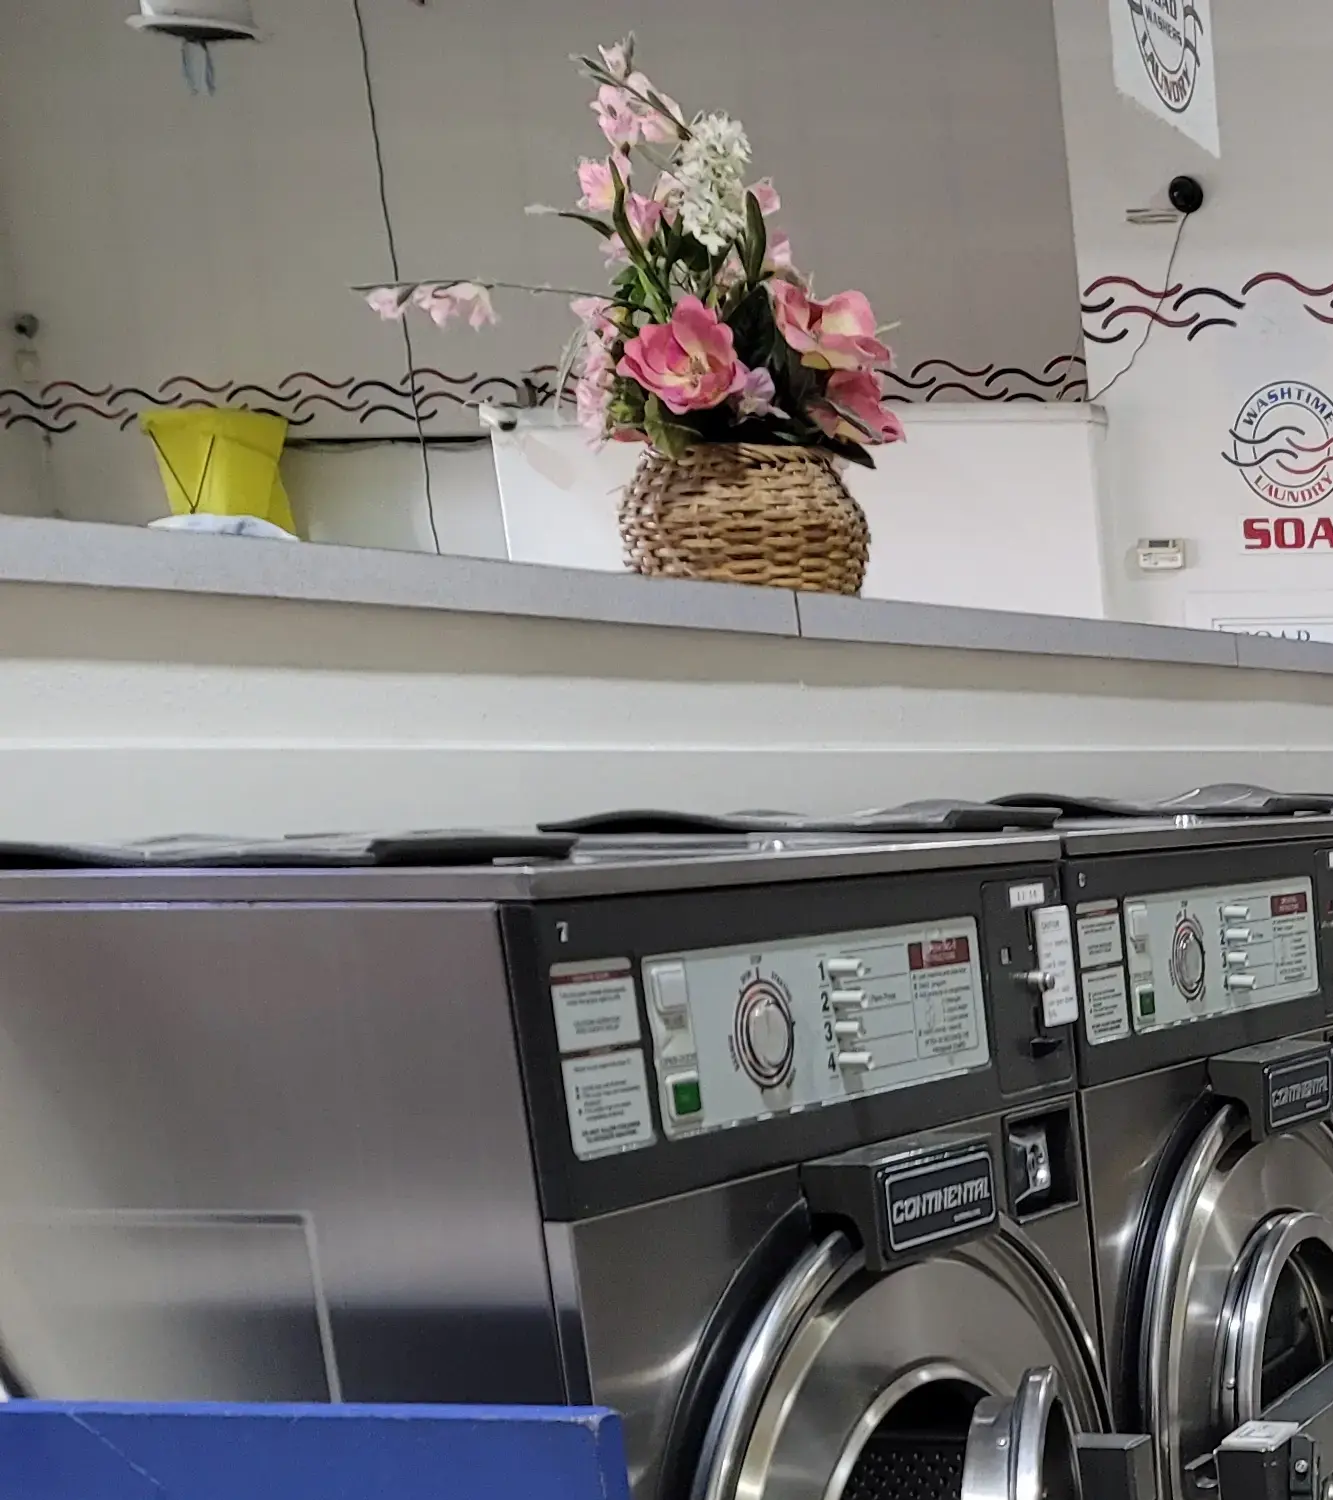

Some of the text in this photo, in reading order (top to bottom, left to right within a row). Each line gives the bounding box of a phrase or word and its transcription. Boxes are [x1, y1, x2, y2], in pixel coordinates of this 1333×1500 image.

[1141, 31, 1191, 103] LAUNDRY
[1253, 471, 1333, 503] LAUNDRY
[556, 921, 569, 943] 7
[817, 960, 826, 981] 1
[821, 992, 830, 1012] 2
[824, 1021, 833, 1042] 3
[827, 1052, 836, 1072] 4
[892, 1176, 991, 1225] CONTINENTAL
